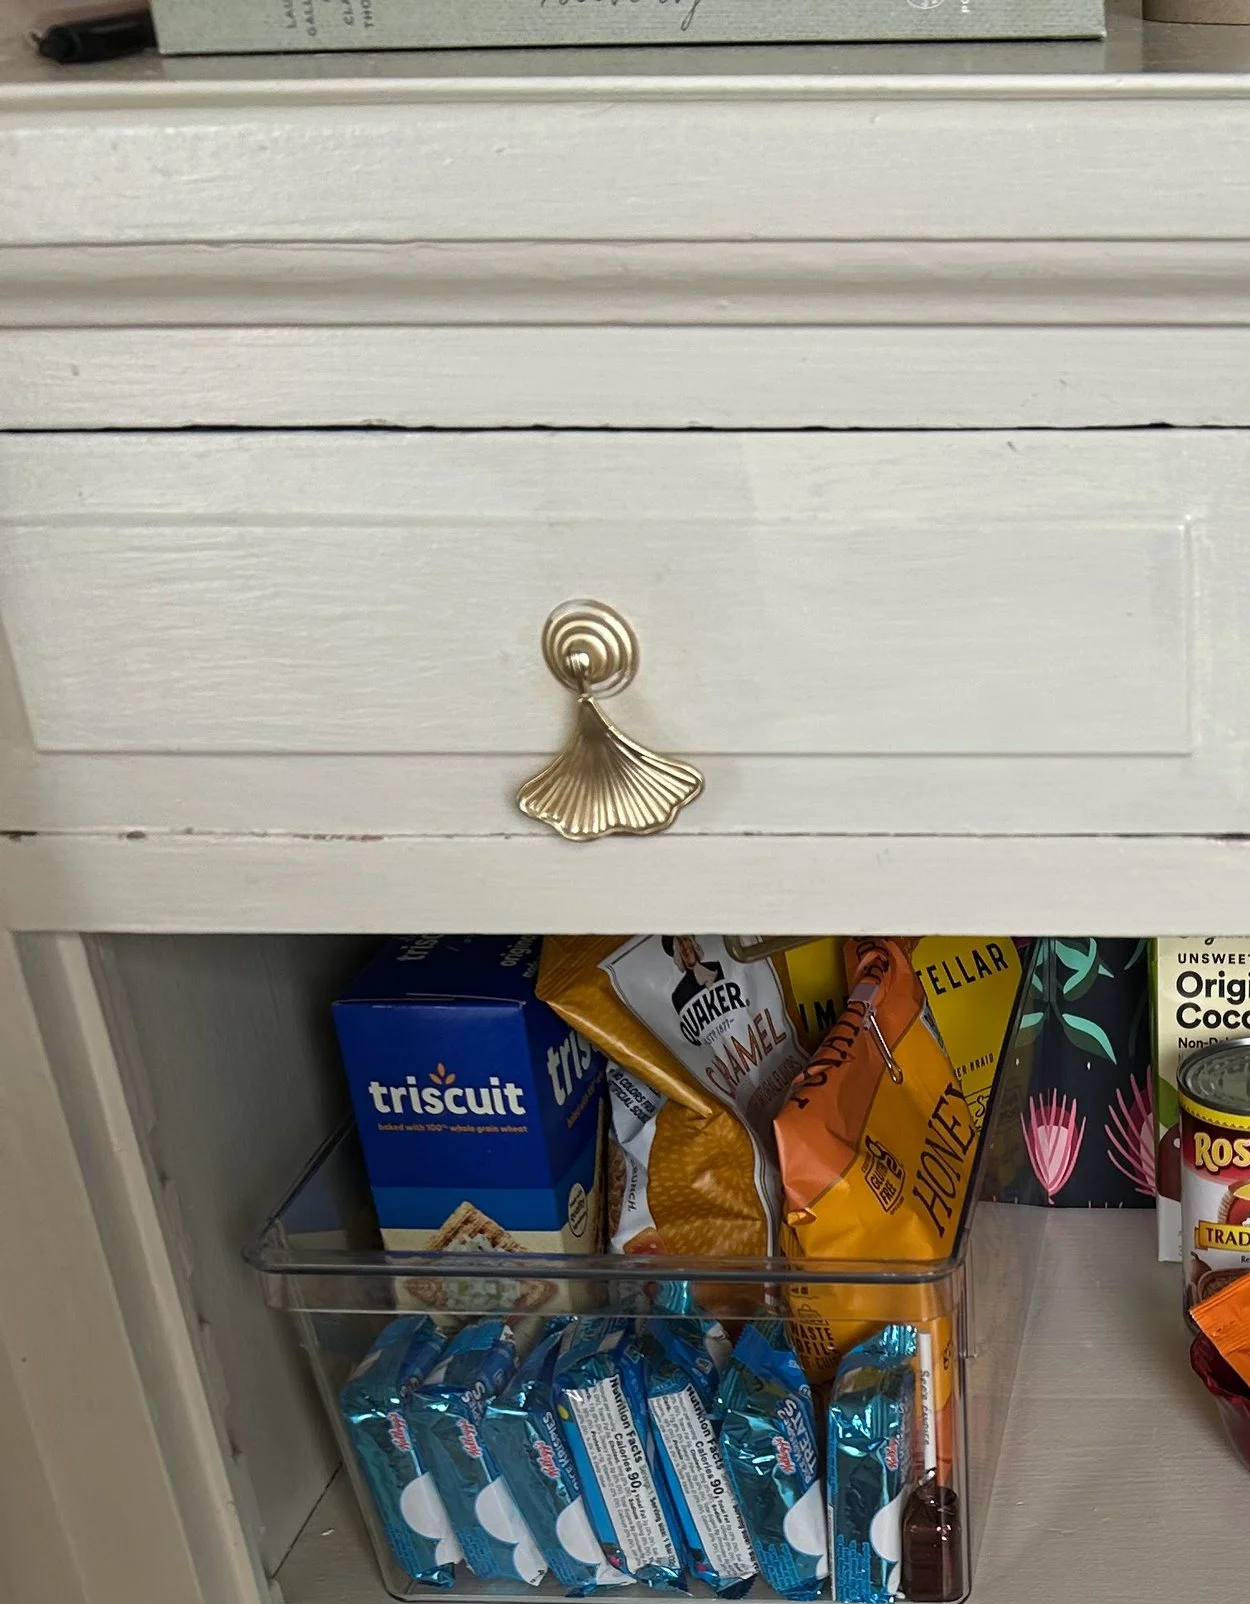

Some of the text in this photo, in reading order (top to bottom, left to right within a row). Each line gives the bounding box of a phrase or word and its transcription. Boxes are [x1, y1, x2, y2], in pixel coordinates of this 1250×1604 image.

[680, 982, 746, 1047] QUAKER
[368, 1075, 526, 1115] triscuit
[911, 1082, 976, 1239] HONEY
[609, 1377, 643, 1464] Nutrition Facts
[686, 1385, 723, 1471] Nutrition Facts
[614, 1432, 632, 1475] Calories
[695, 1440, 714, 1482] Calories
